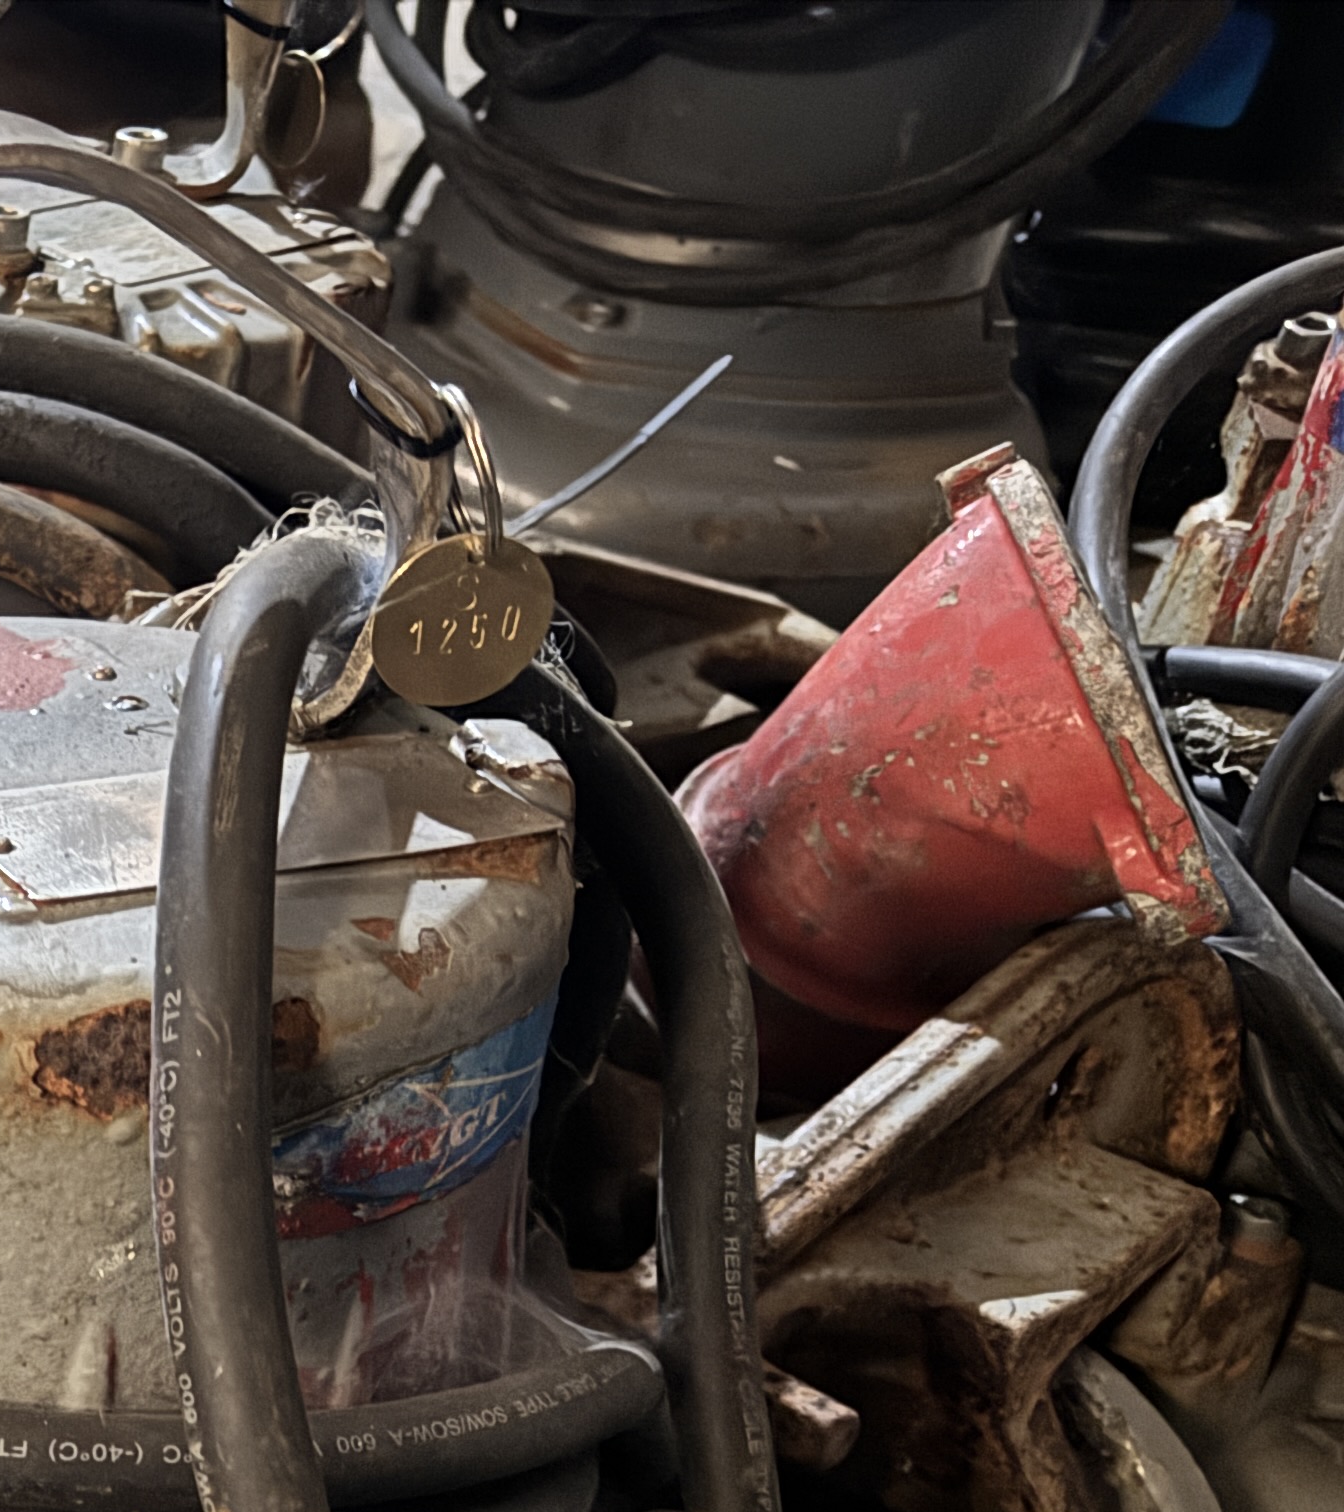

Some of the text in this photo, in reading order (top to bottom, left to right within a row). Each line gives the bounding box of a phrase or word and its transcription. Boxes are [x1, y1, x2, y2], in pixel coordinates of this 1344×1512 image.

[408, 604, 522, 656] 1250
[162, 988, 182, 1043] FT2
[723, 1143, 742, 1222] WATER
[164, 1262, 186, 1358] VOLTS
[178, 1373, 198, 1425] 600
[514, 1391, 560, 1419] TYPE
[335, 1432, 377, 1455] 600
[387, 1404, 509, 1448] SOW/SOW-A
[48, 1438, 143, 1465] (-40°C)
[162, 1444, 194, 1464] °C
